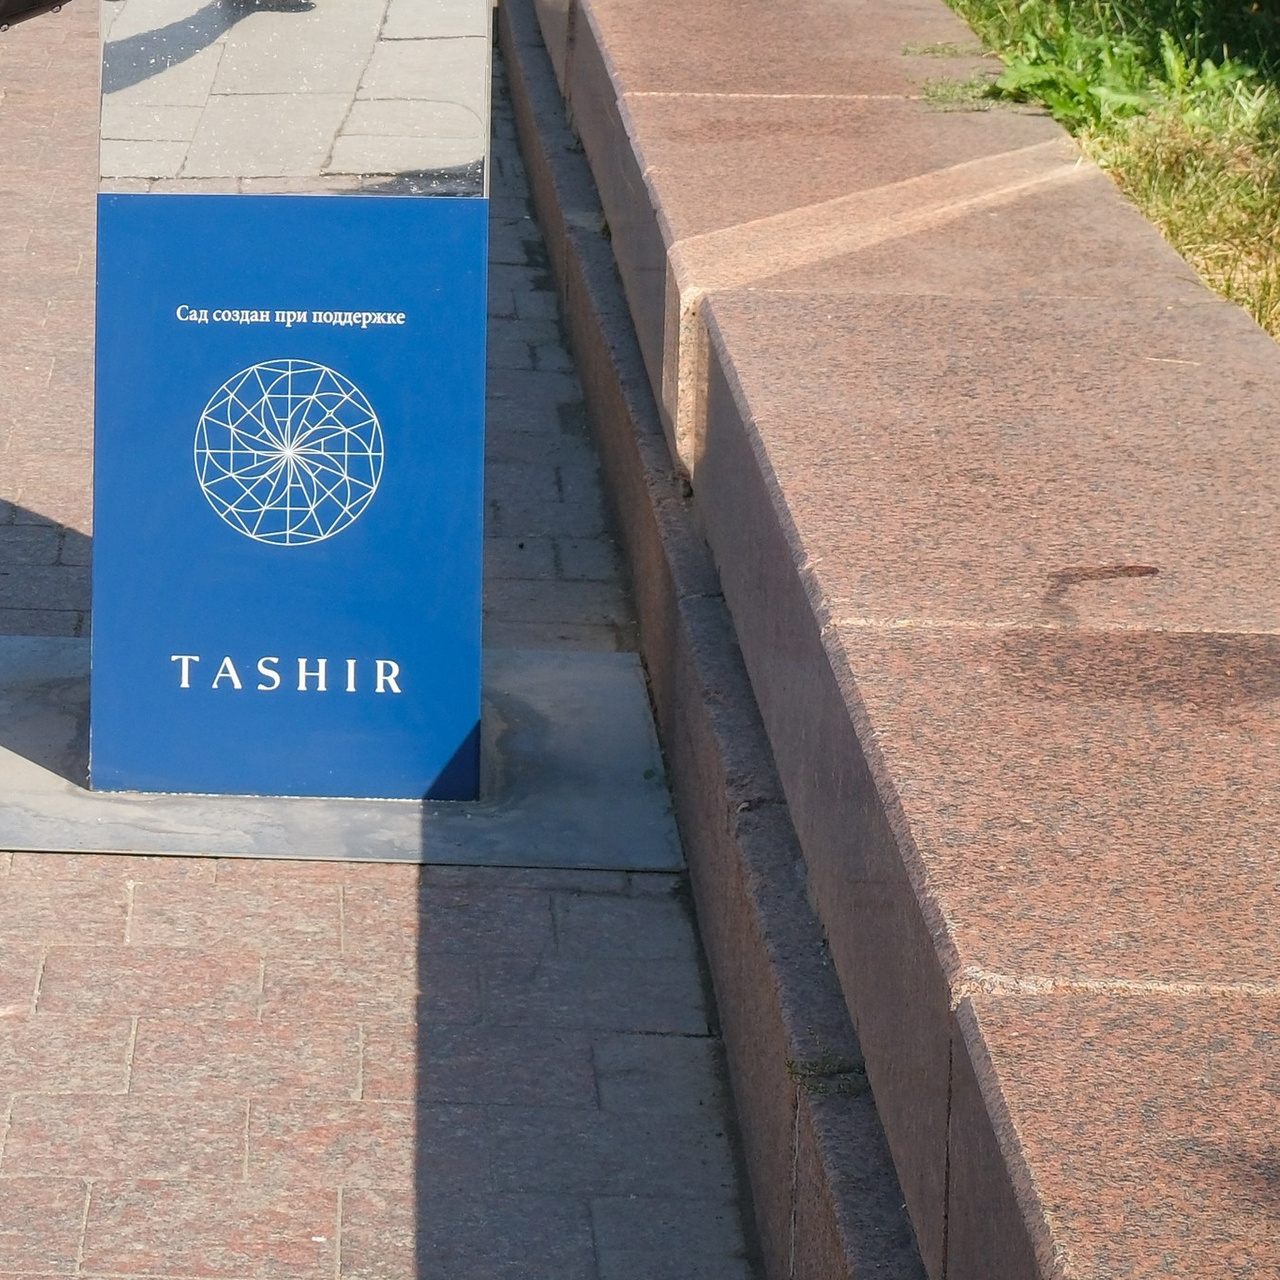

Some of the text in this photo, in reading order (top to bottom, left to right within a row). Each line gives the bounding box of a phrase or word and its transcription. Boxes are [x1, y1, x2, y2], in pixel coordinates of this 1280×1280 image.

[176, 304, 407, 329] Сад создан при поддержке
[170, 654, 403, 694] TASHIR
